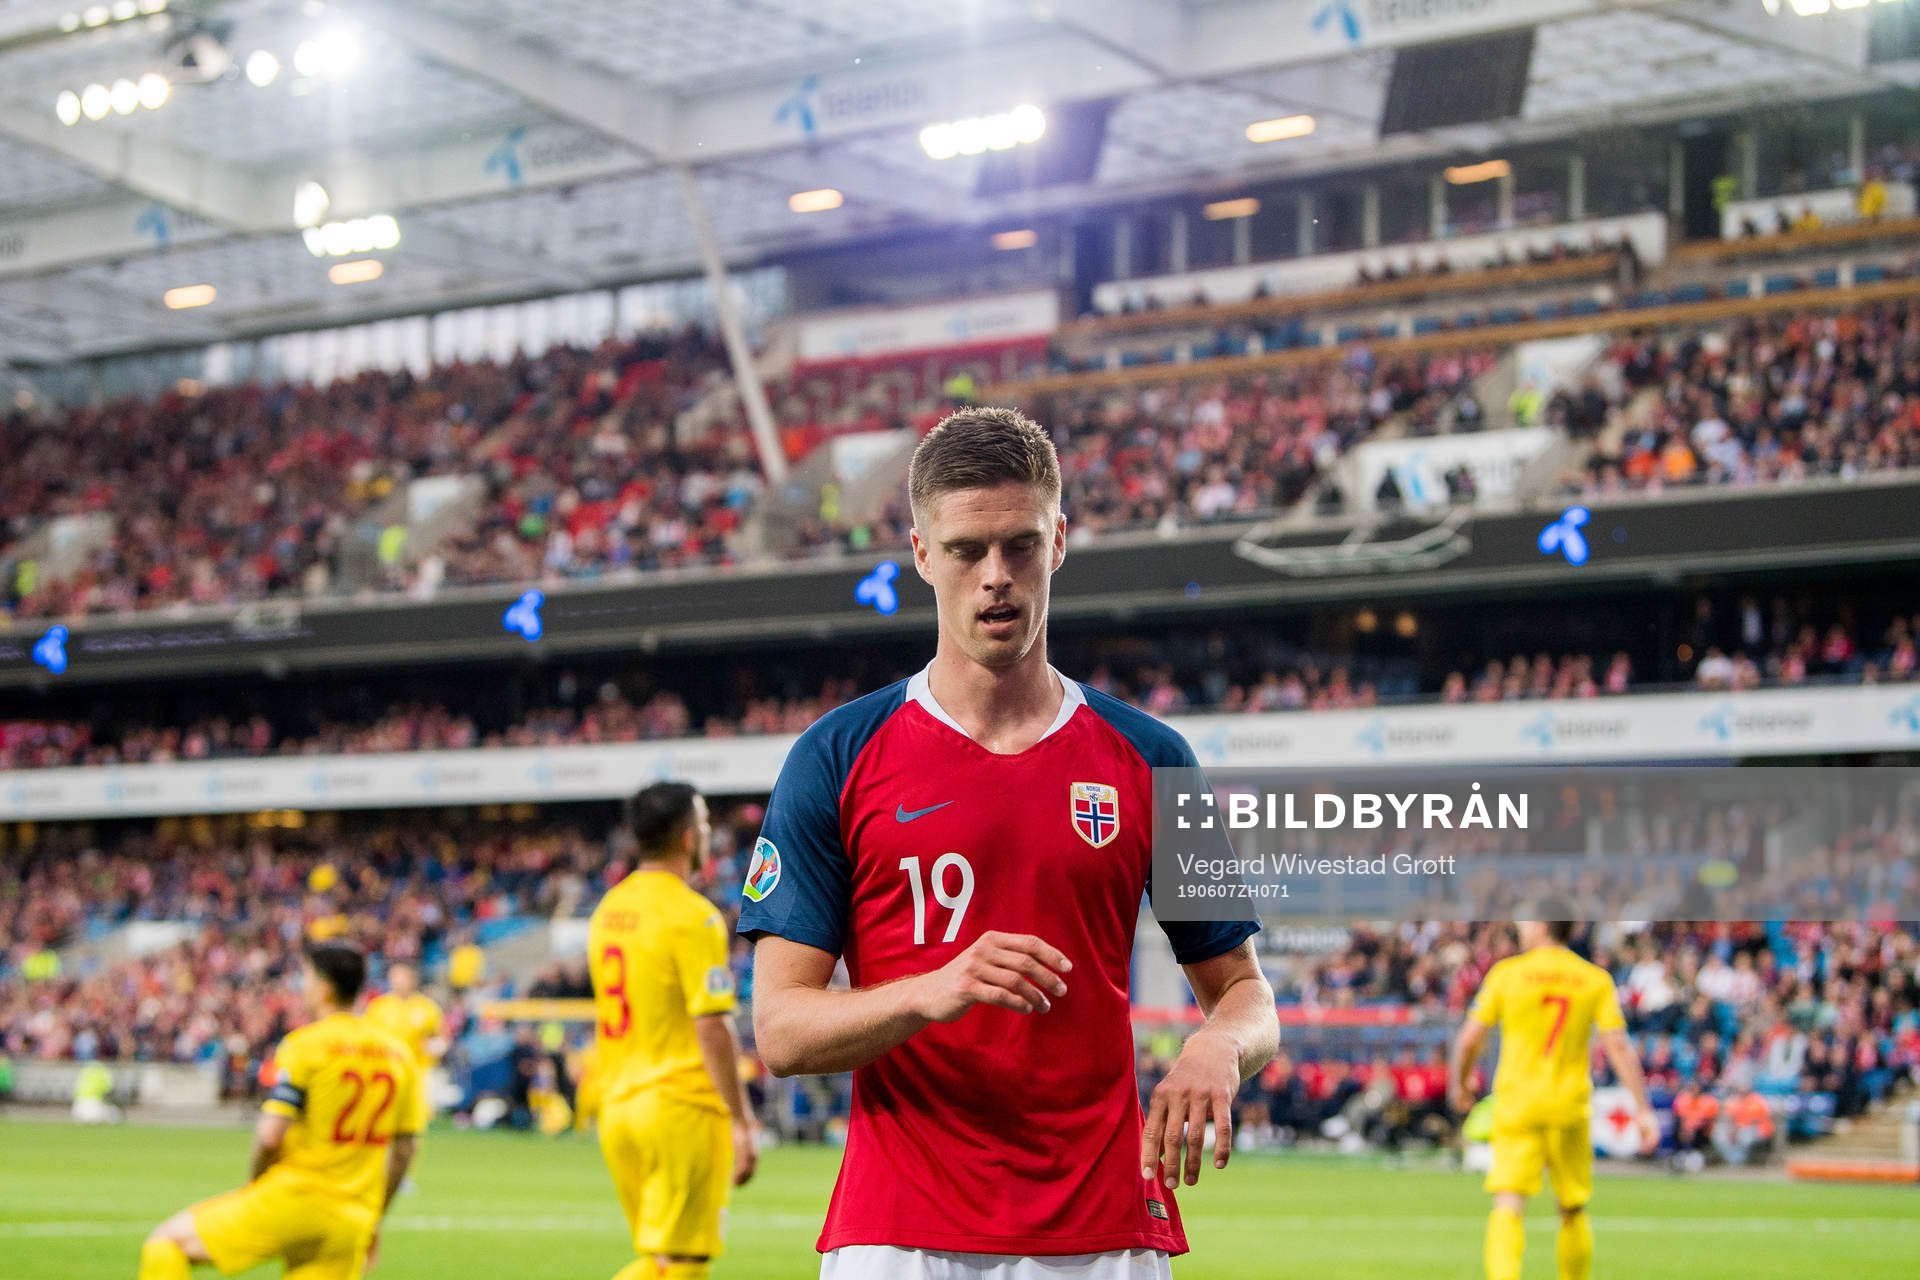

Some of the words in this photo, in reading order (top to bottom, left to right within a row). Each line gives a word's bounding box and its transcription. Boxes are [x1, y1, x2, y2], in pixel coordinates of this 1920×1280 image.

[899, 852, 975, 945] 19
[601, 944, 631, 1040] 3
[1541, 994, 1570, 1057] 7
[331, 1069, 398, 1145] 22
